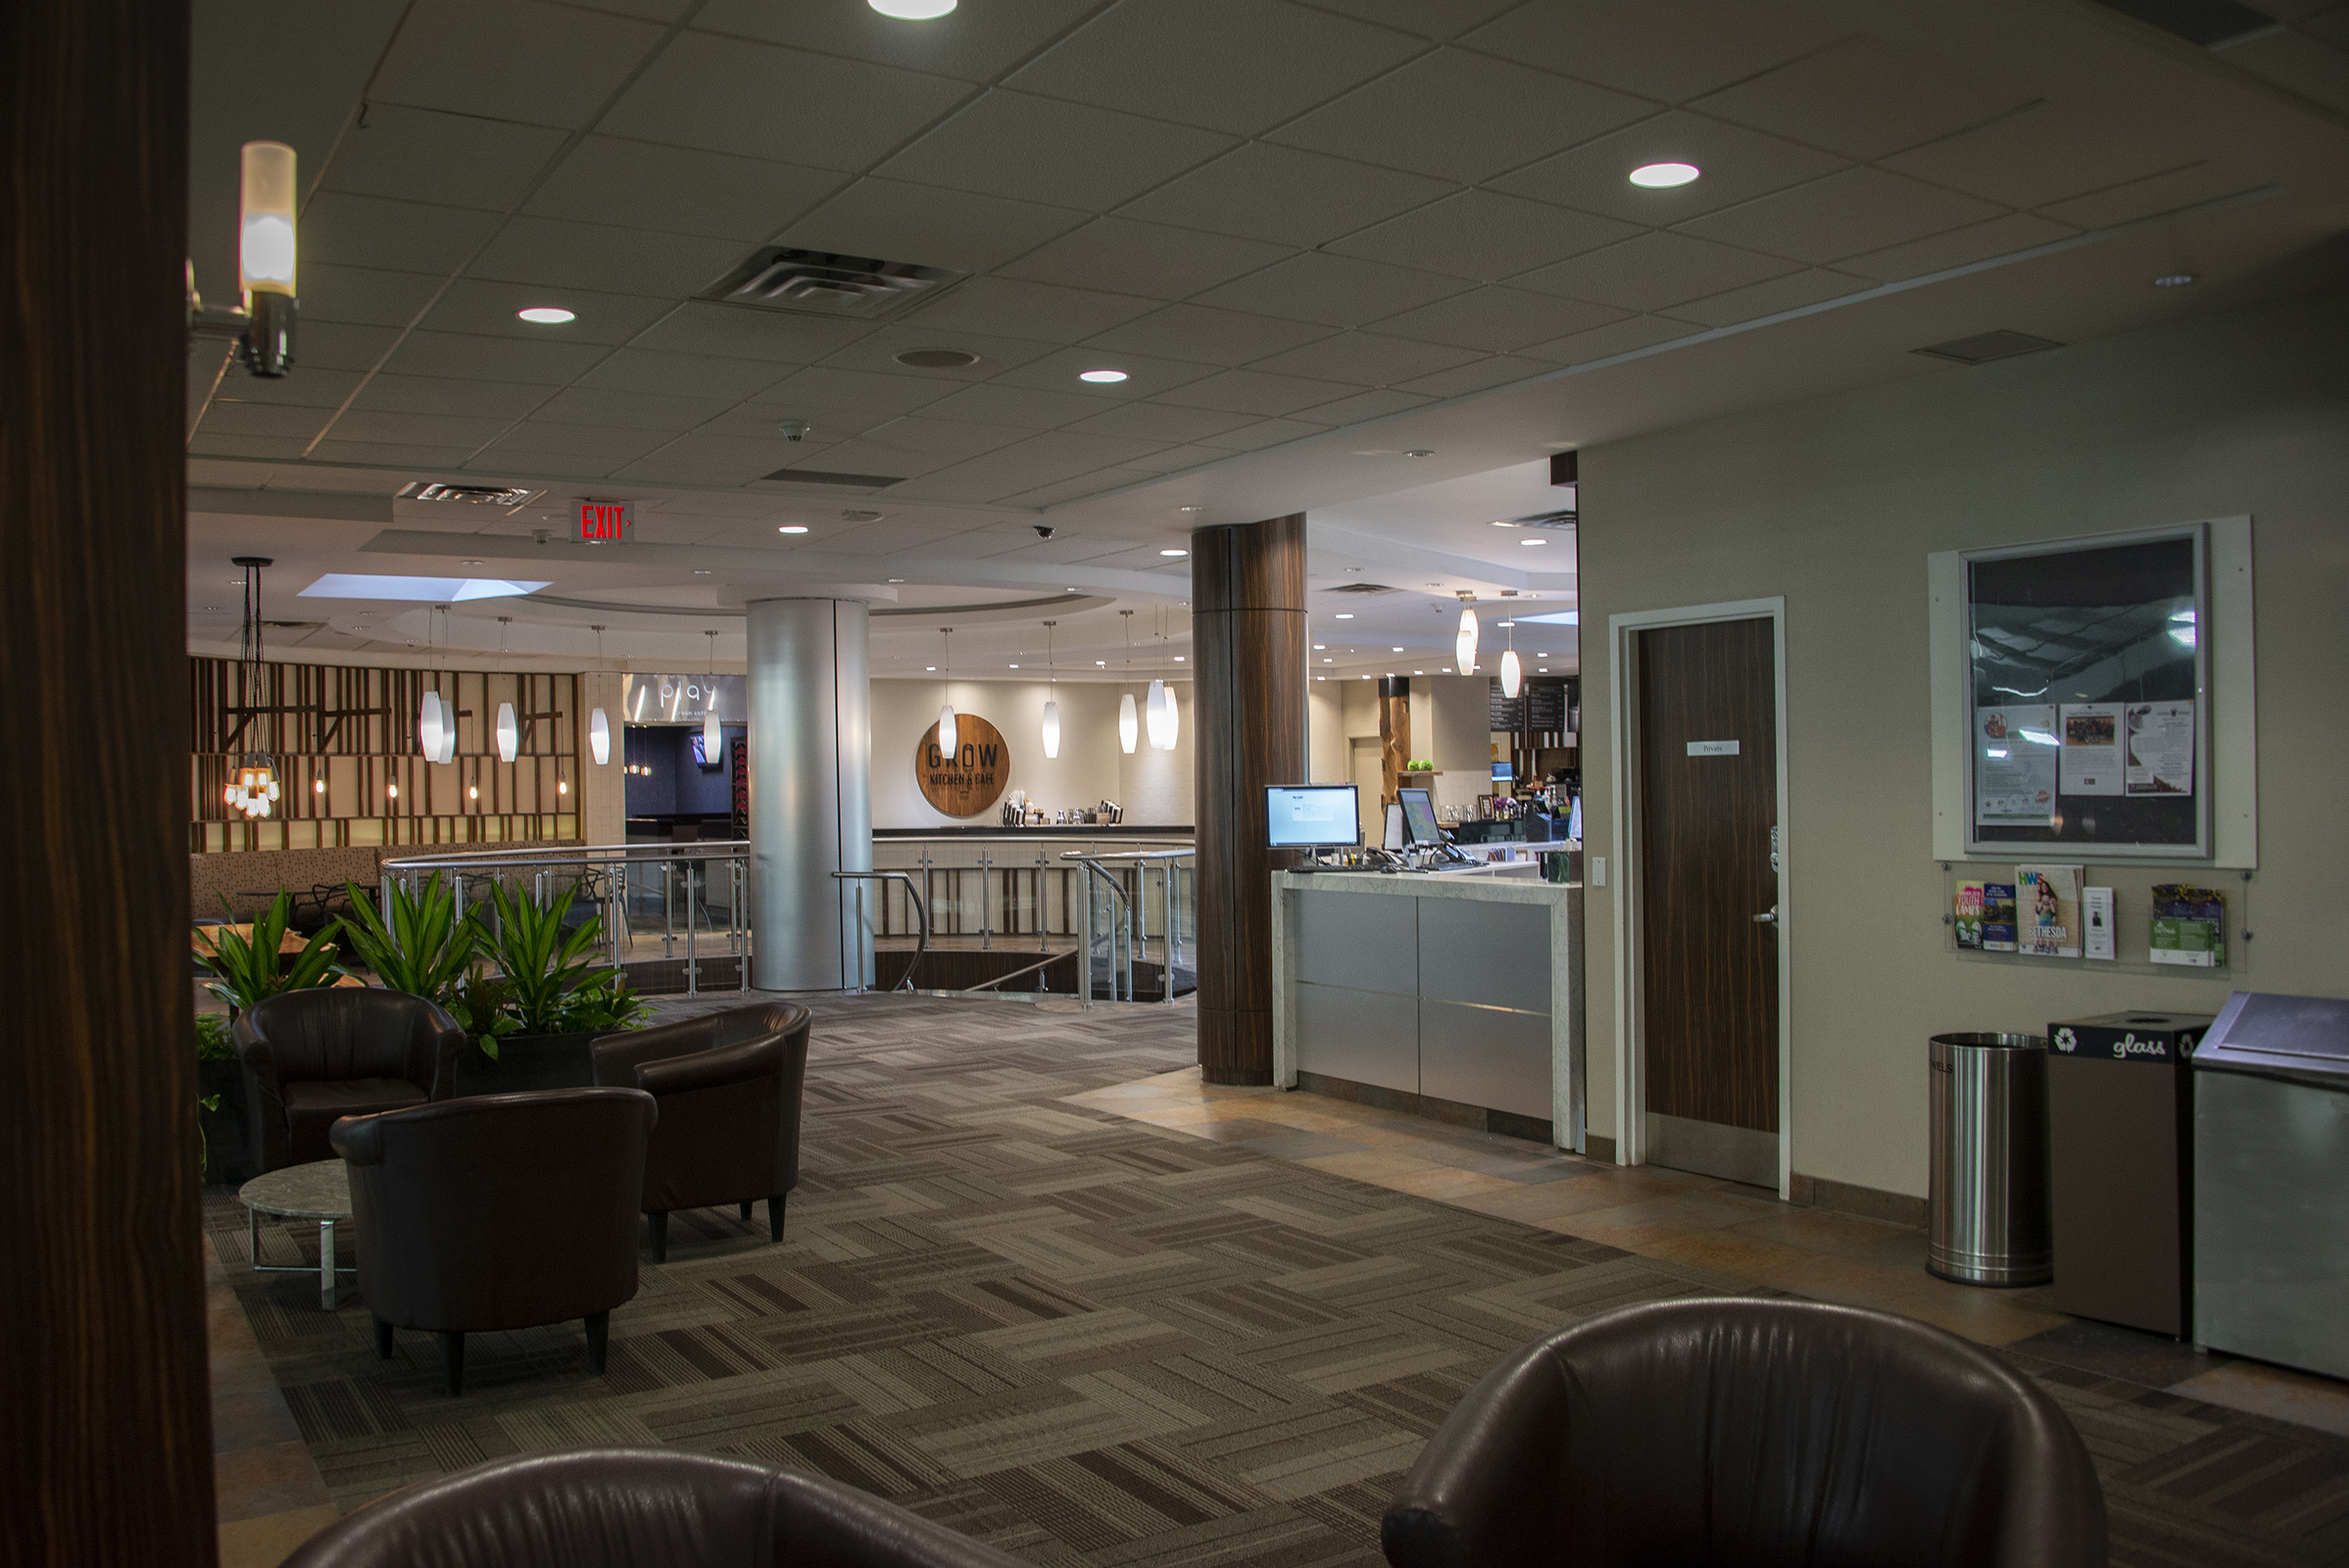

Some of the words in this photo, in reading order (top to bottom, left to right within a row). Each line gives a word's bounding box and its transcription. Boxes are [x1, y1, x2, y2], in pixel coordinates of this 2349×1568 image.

[581, 505, 624, 539] EXIT
[661, 680, 716, 710] play
[930, 773, 964, 786] KITCHEN
[966, 773, 973, 785] &
[975, 773, 995, 785] CAFE
[2019, 872, 2044, 885] HWS
[1958, 896, 1980, 906] YOUTH
[2028, 925, 2067, 939] BETHESDA
[2113, 1033, 2166, 1058] glass
